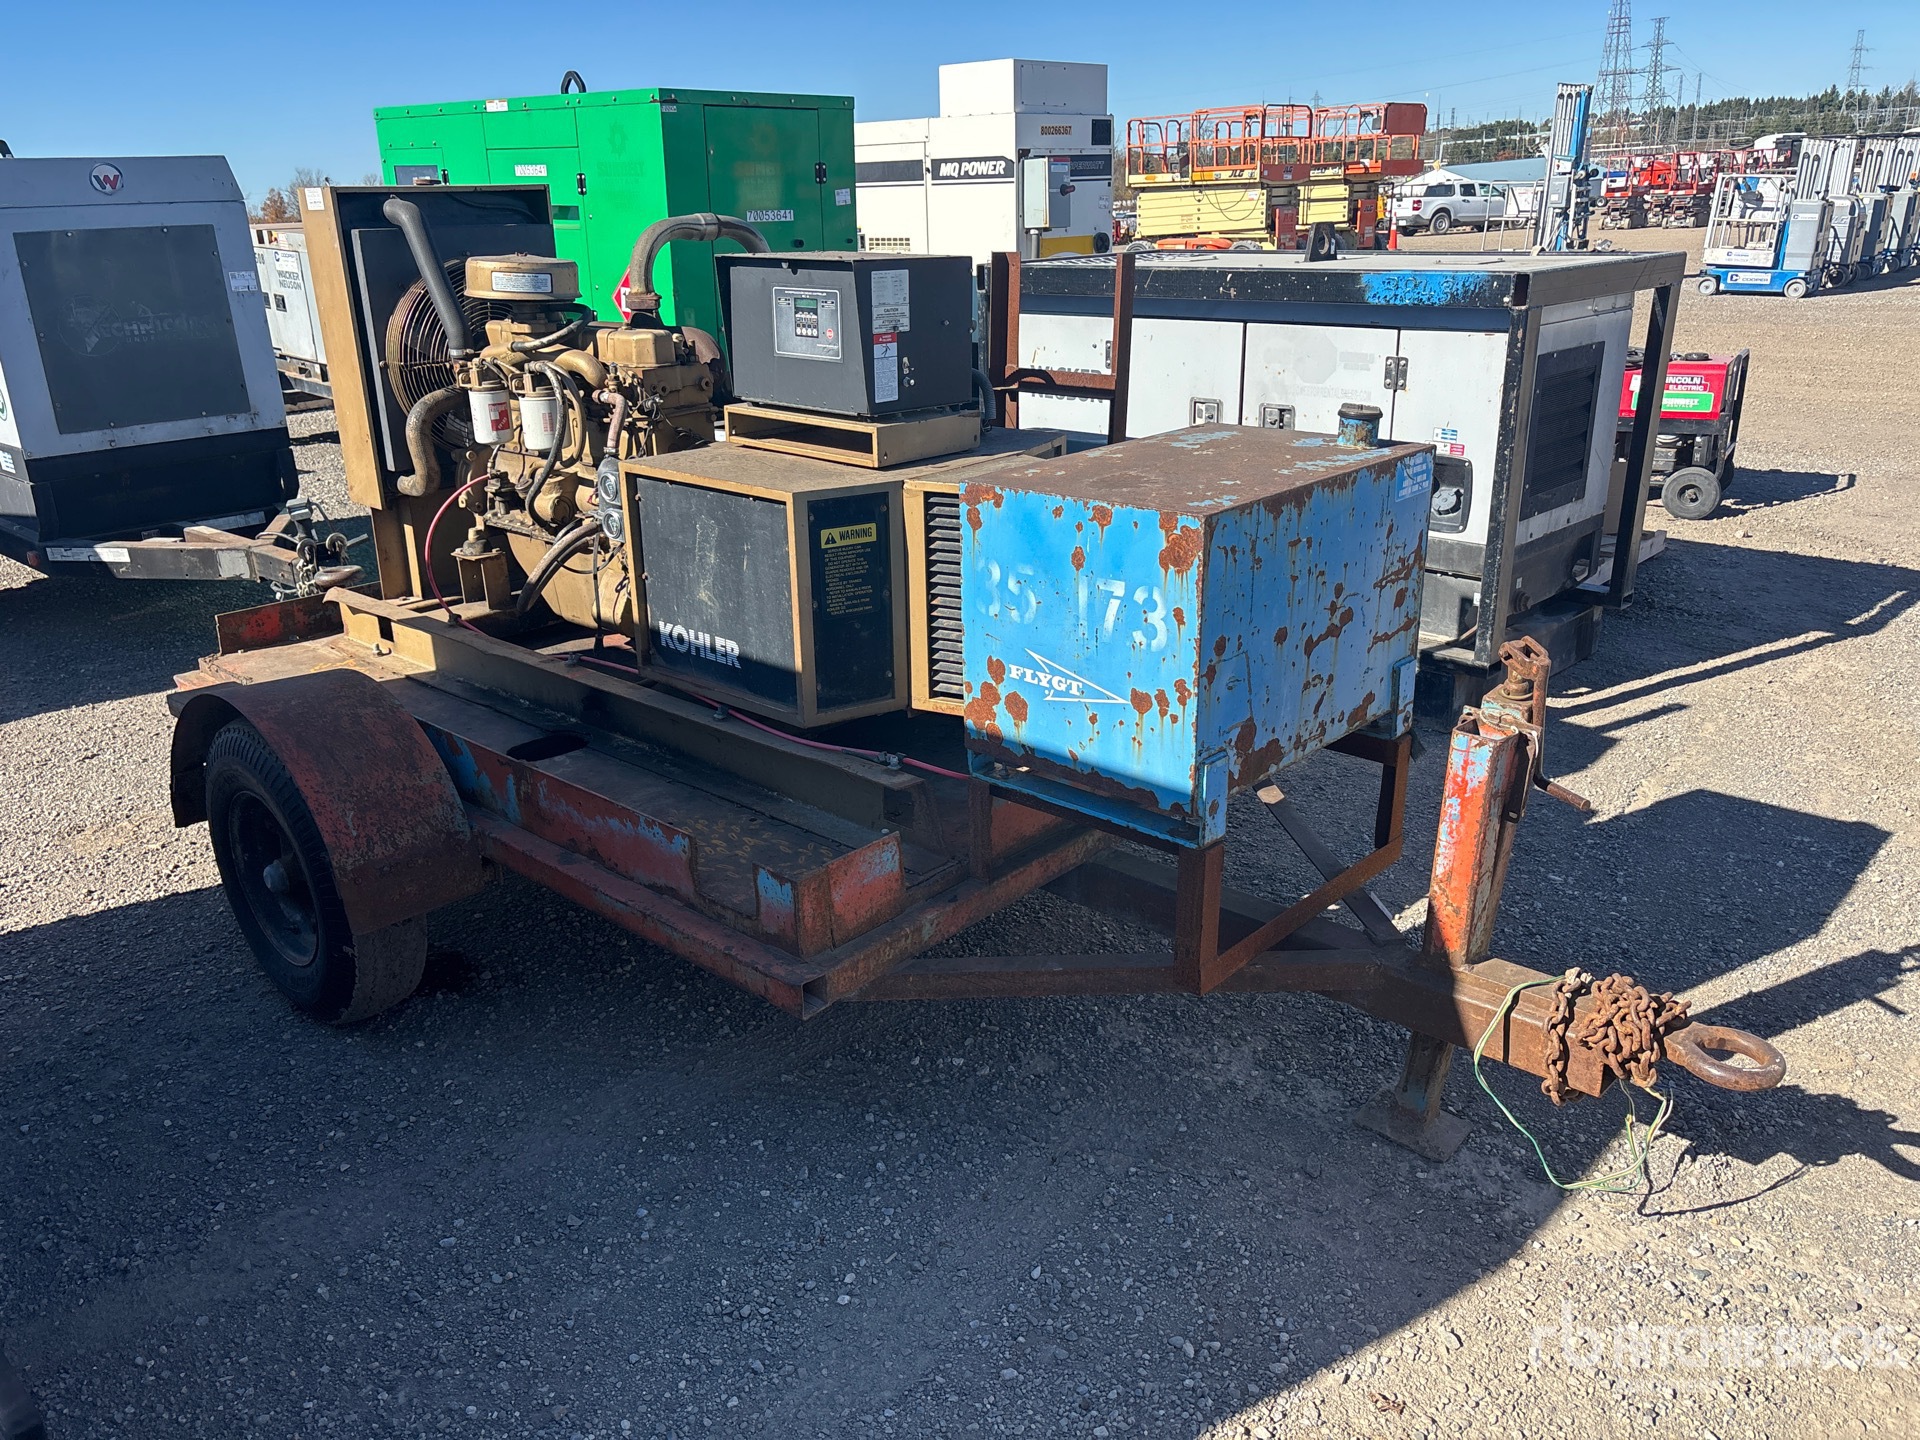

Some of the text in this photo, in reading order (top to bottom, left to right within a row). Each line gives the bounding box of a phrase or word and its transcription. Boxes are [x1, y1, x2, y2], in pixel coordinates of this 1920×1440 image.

[1040, 126, 1072, 136] 800266367
[940, 160, 1006, 178] MQ POWER
[1229, 170, 1244, 178] JLG
[748, 210, 793, 222] 70053641
[277, 270, 300, 280] WACKER
[280, 280, 302, 290] NEUSON
[1666, 376, 1702, 384] INCOLN
[839, 527, 872, 541] WARNING
[1078, 575, 1168, 652] 173
[659, 620, 741, 668] KOHLER
[1009, 664, 1082, 696] FLYGT
